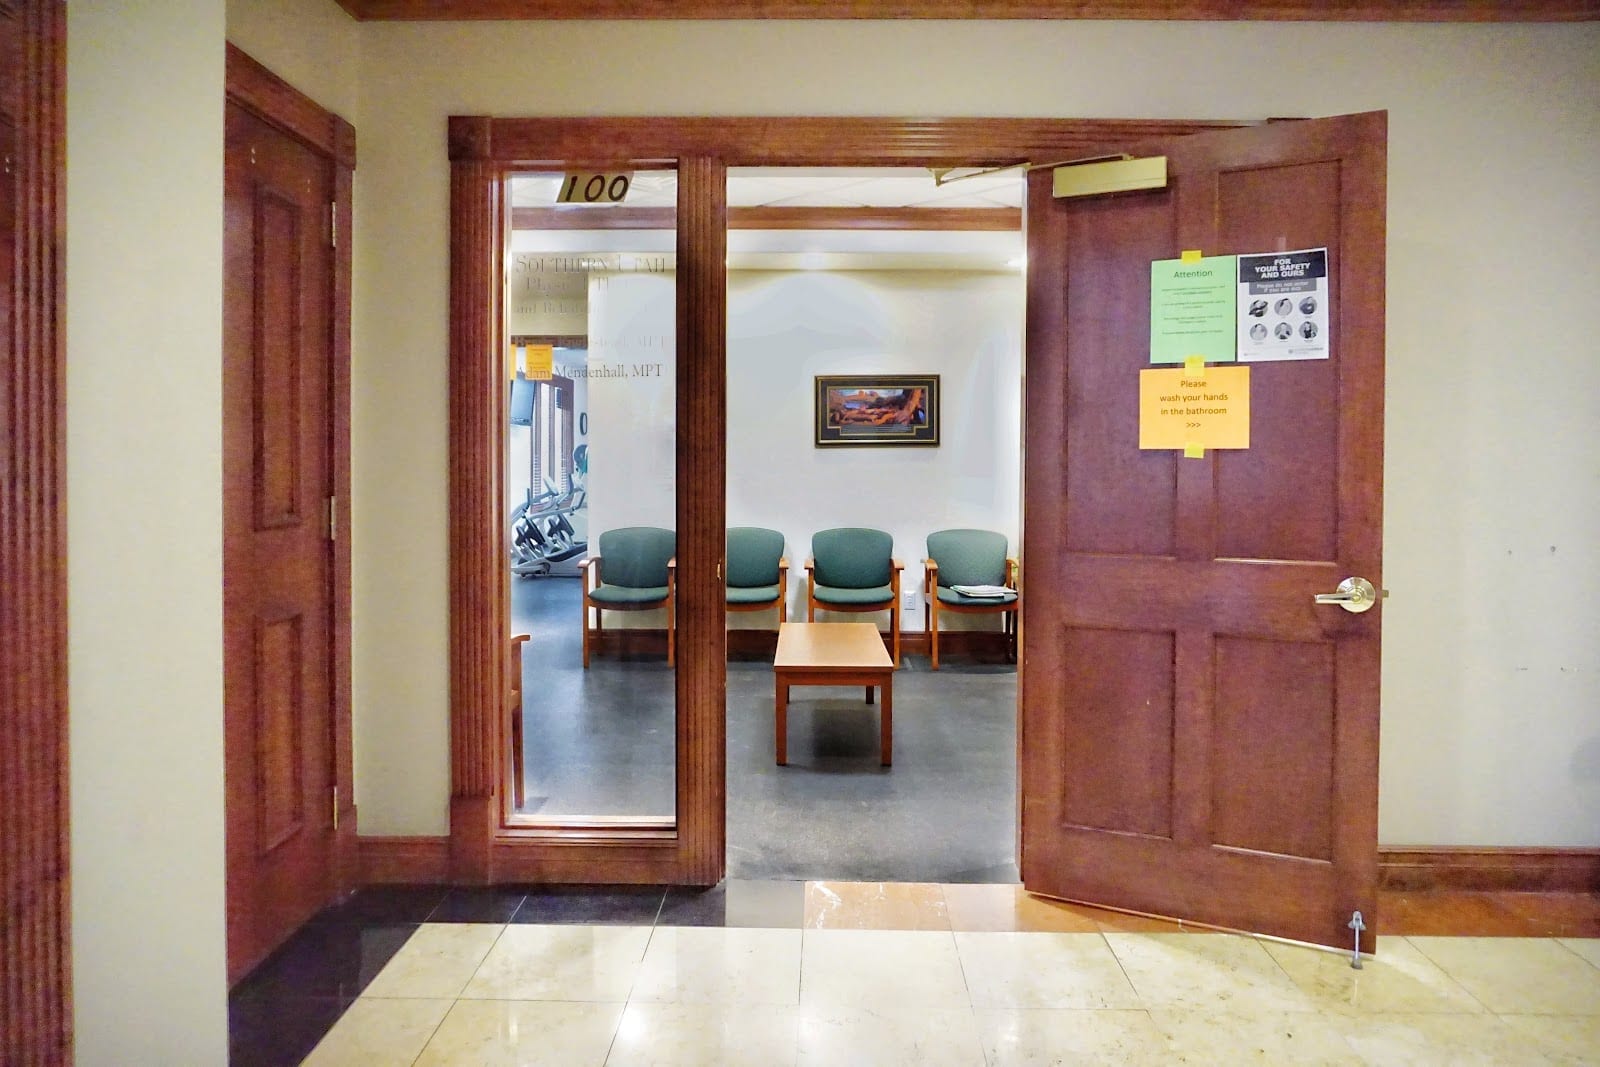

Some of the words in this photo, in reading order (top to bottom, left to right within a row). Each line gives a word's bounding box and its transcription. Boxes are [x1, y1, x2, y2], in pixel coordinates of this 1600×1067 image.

[565, 175, 629, 202] 100
[1274, 258, 1292, 266] FOR
[1255, 264, 1279, 273] YOUR
[1280, 263, 1311, 272] SAFETY
[1173, 270, 1213, 279] Attention
[1281, 270, 1304, 278] OURS
[555, 364, 629, 379] Mendenhall,
[632, 364, 663, 378] MPT
[1180, 380, 1207, 388] Please
[1160, 394, 1181, 402] wash
[1182, 394, 1201, 402] your
[1203, 393, 1229, 401] hands
[1186, 407, 1227, 415] bathroom
